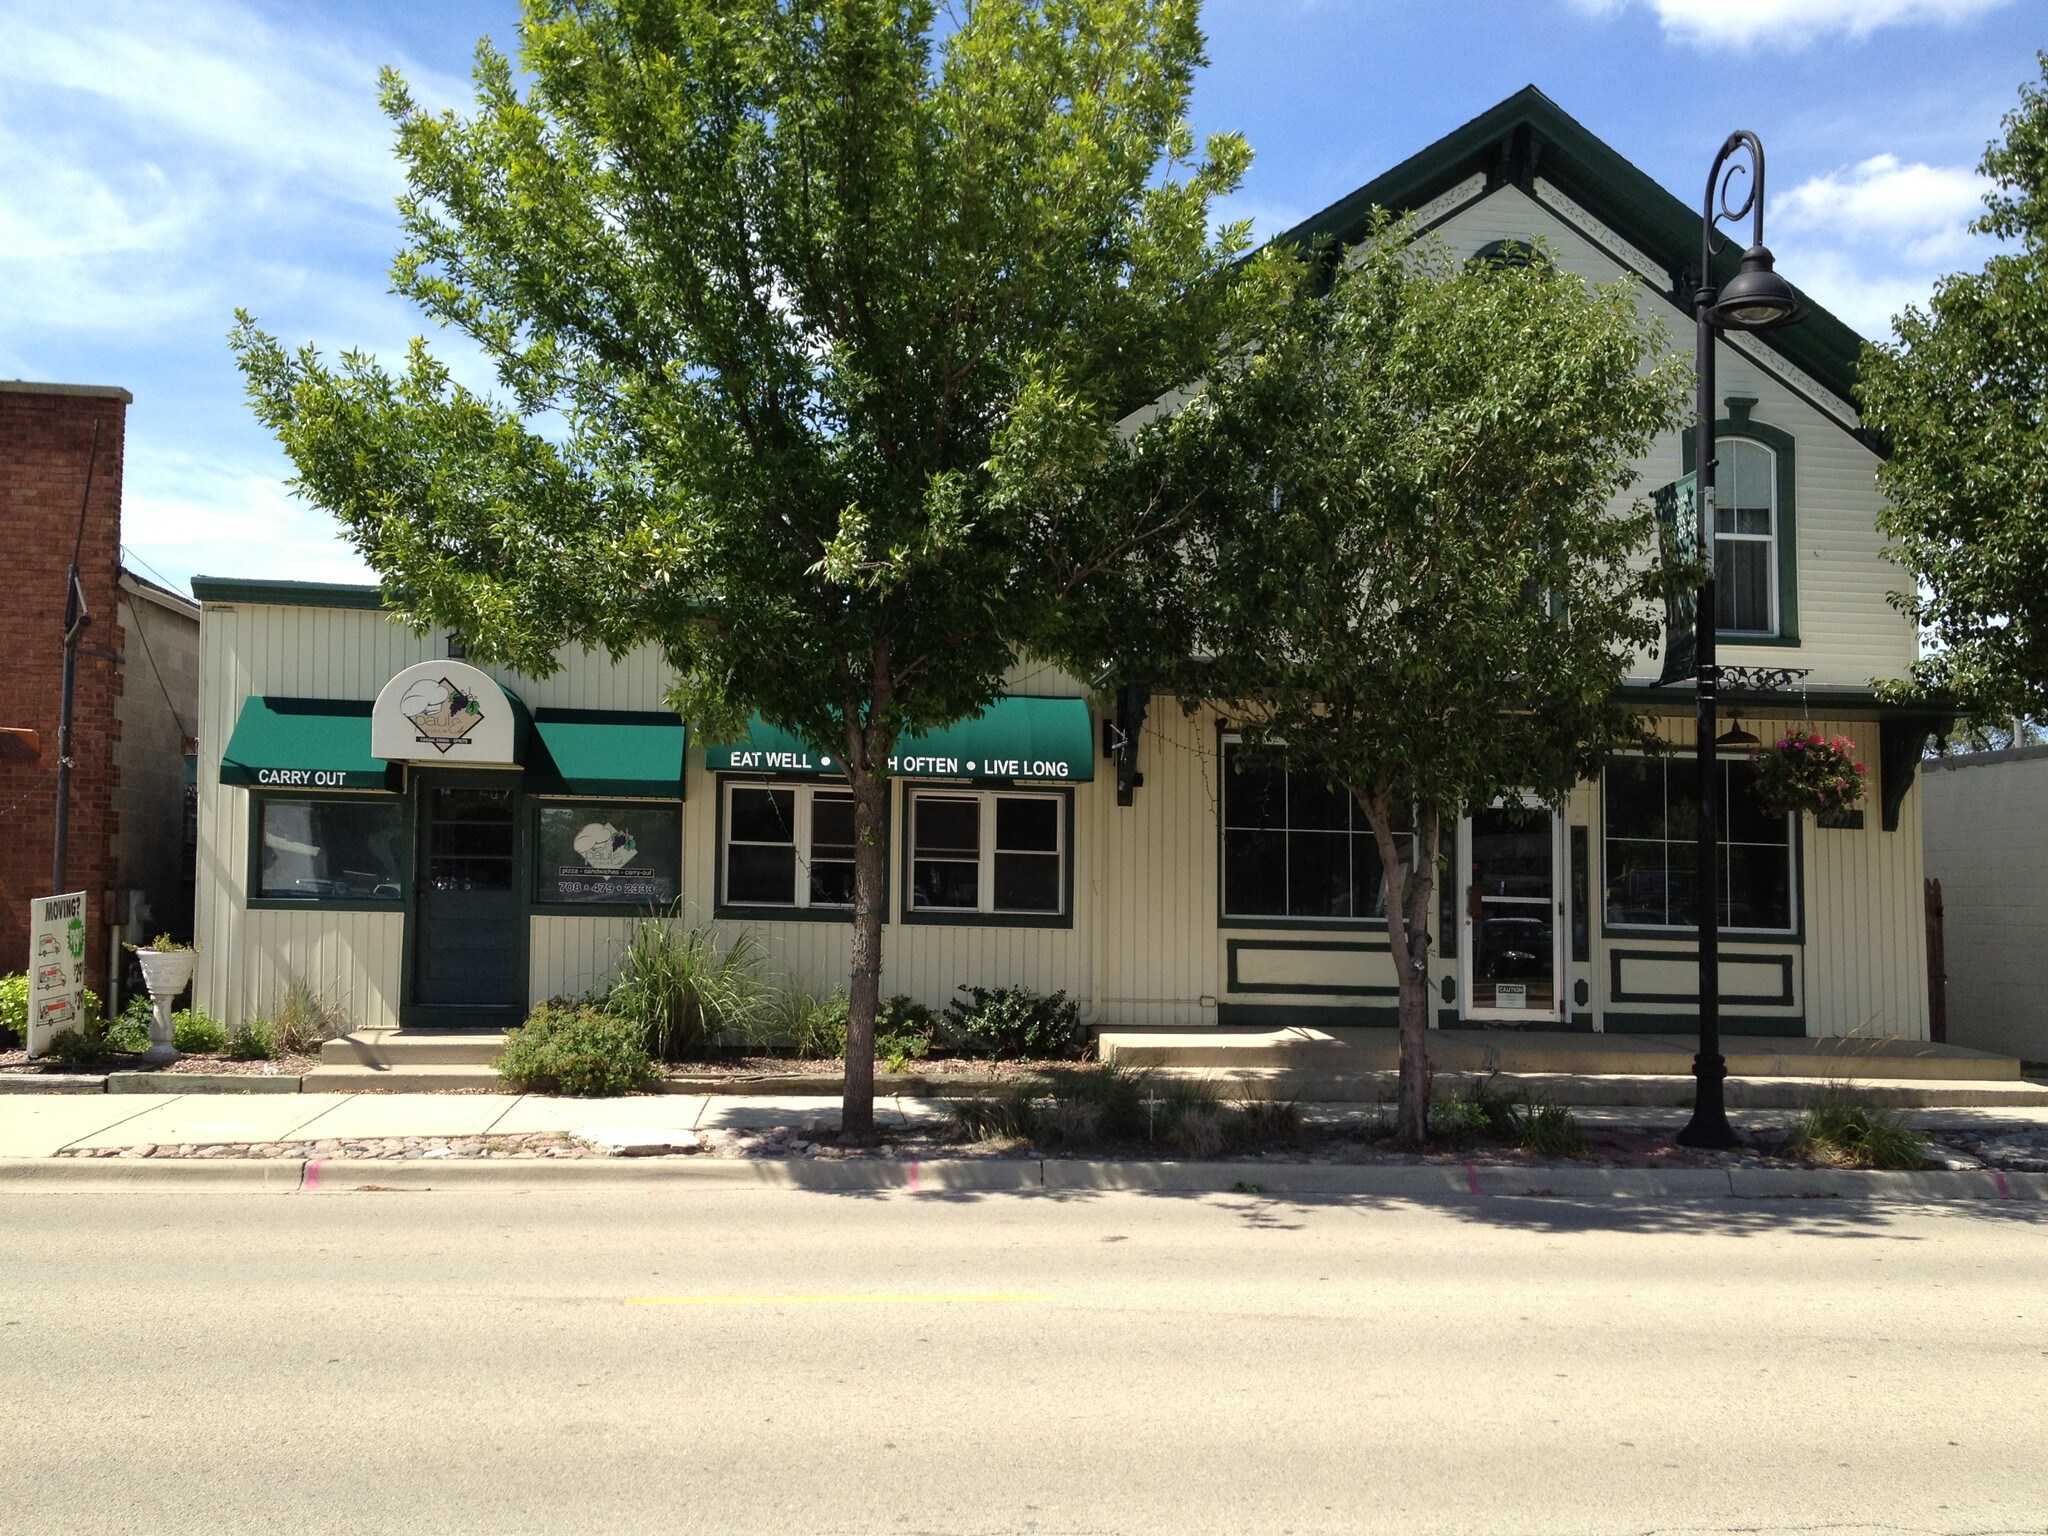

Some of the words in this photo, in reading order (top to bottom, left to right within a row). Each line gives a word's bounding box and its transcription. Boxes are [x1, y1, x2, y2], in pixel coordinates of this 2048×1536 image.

[730, 751, 762, 767] EAT
[766, 752, 812, 769] WELL
[903, 756, 958, 773] OFTEN
[984, 759, 1019, 775] LIVE
[1024, 760, 1069, 777] LONG
[258, 769, 311, 784] CARRY
[314, 771, 346, 786] OUT
[624, 869, 653, 877] carry-out
[558, 881, 582, 892] 708
[592, 882, 615, 893] 479
[624, 883, 655, 895] 2333
[44, 896, 81, 922] MOVING?
